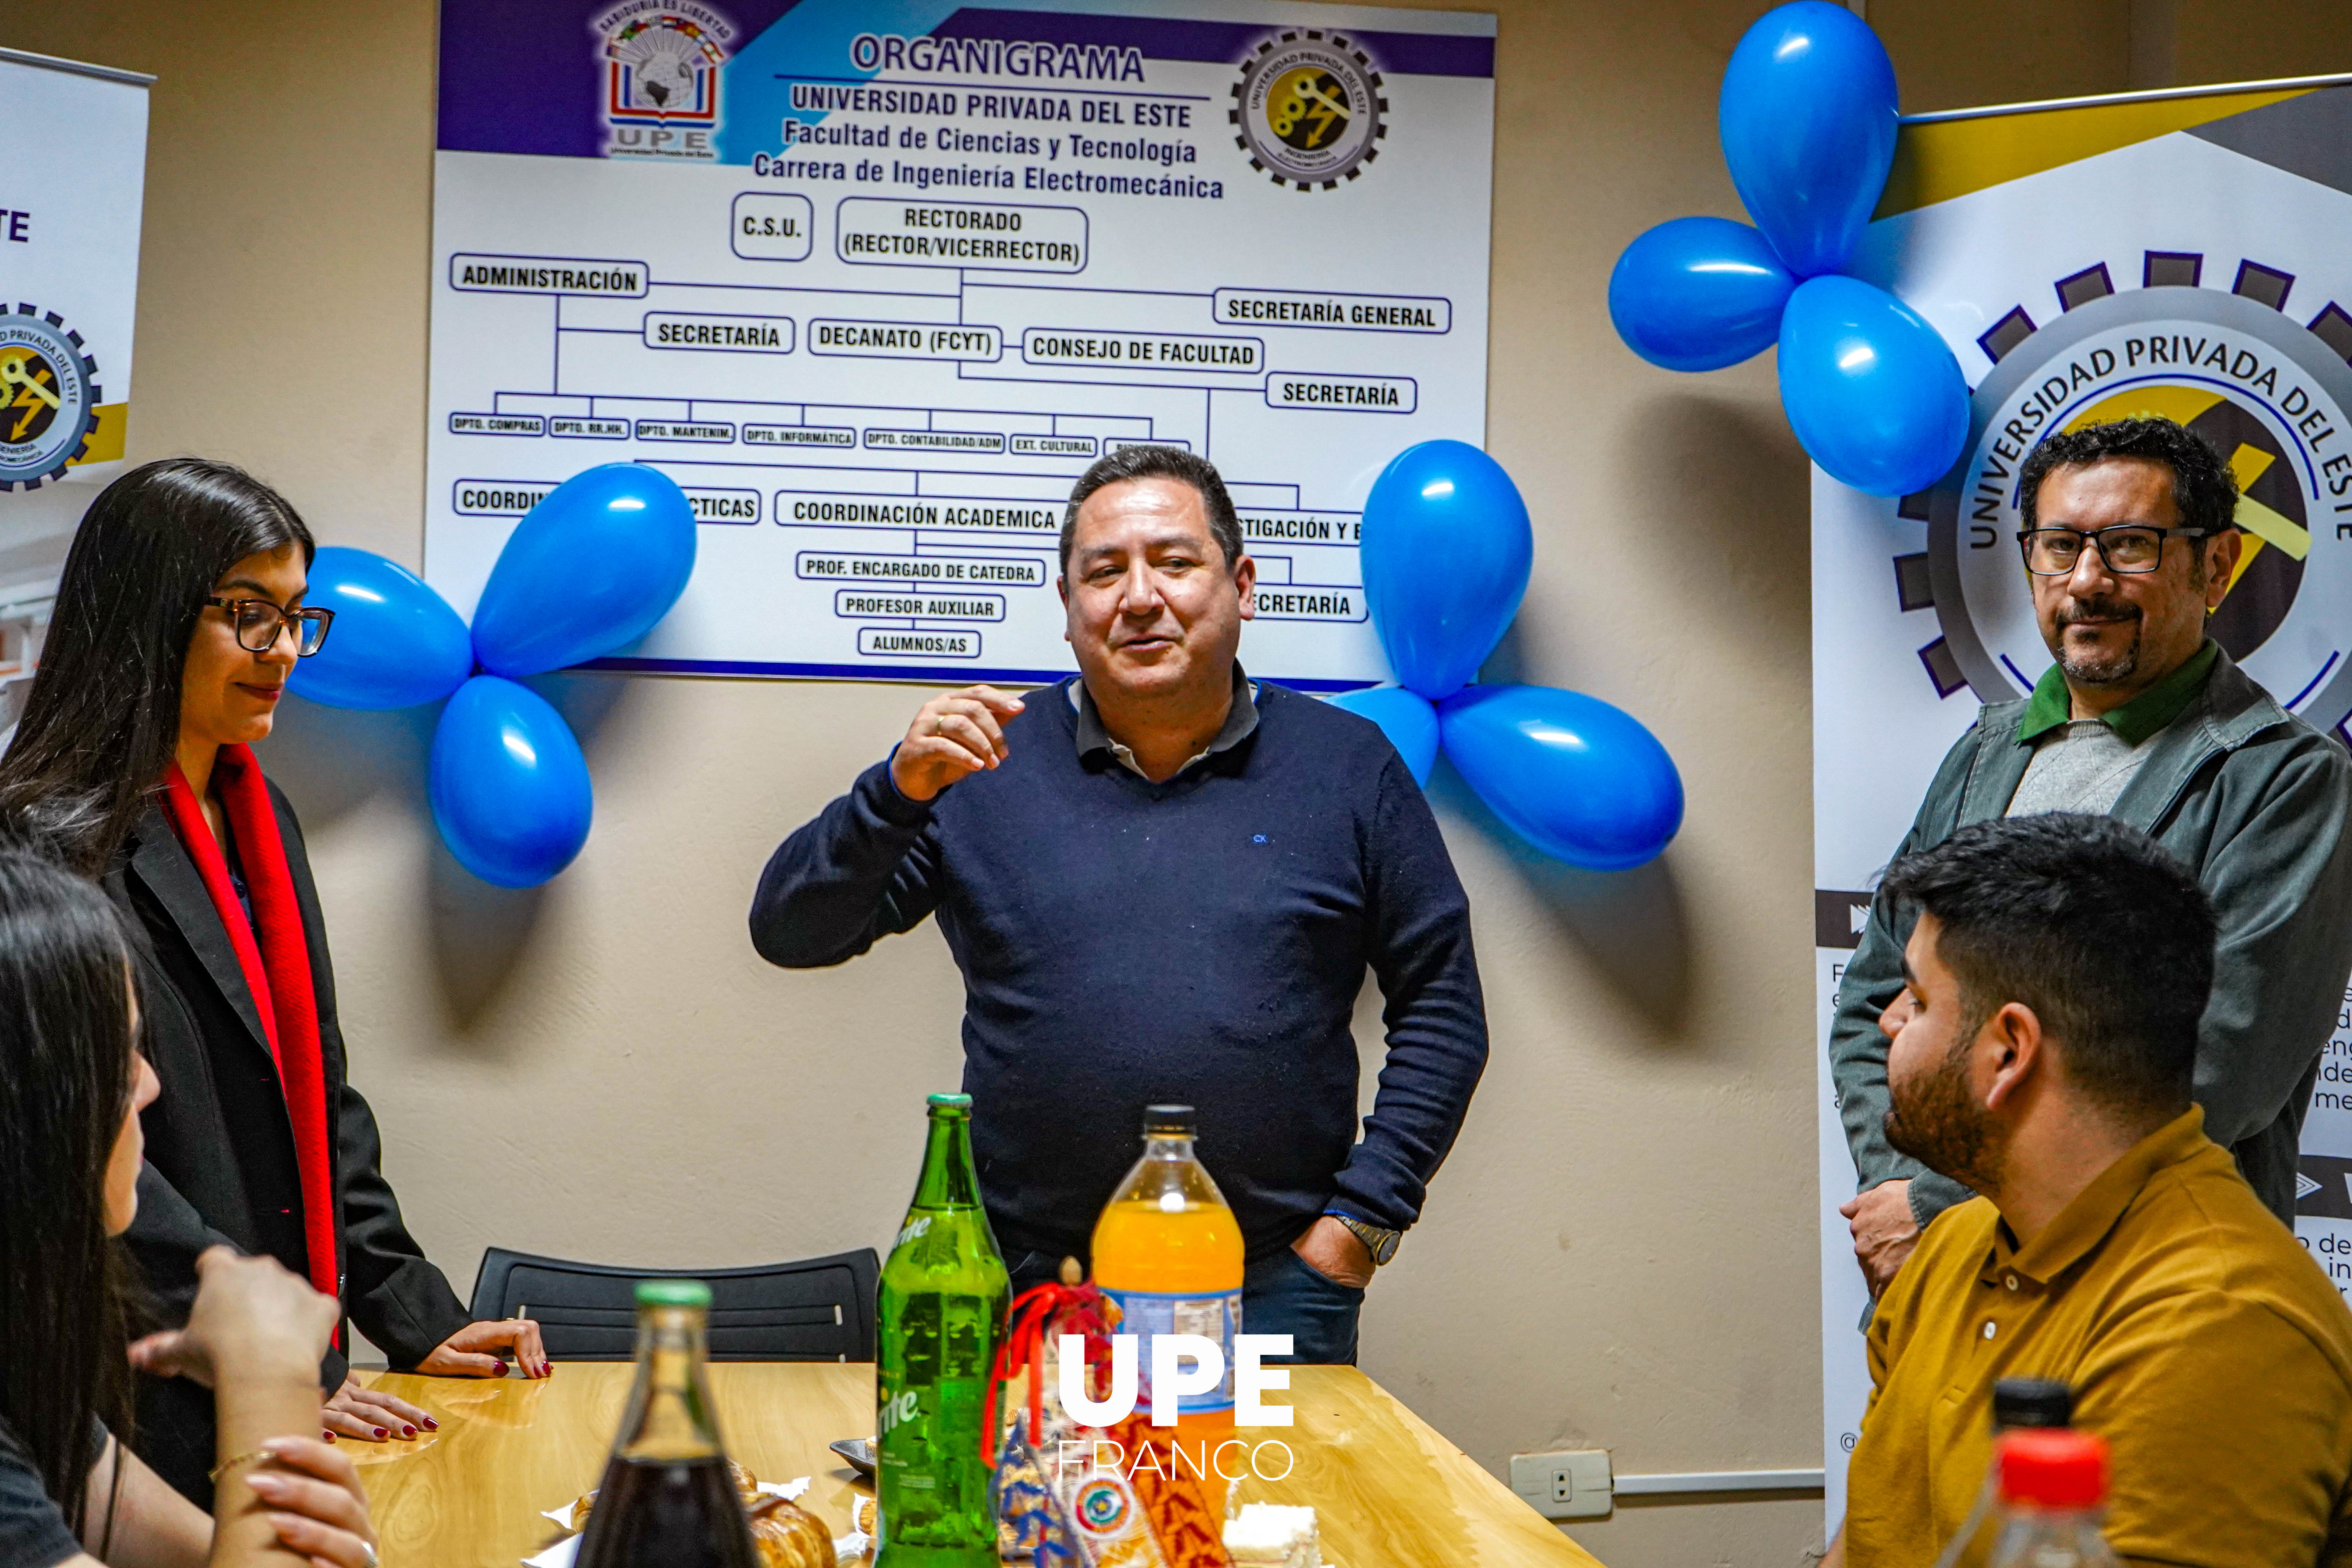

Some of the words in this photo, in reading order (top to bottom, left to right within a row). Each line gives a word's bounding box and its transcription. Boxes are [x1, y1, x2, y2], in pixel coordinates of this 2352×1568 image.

[854, 36, 1145, 83] ORGANIGRAMA
[793, 85, 956, 116] UNIVERSIDAD
[967, 94, 1071, 121] PRIVADA
[1082, 101, 1125, 124] DEL
[1134, 103, 1191, 128] ESTE
[618, 129, 708, 149] UPE
[785, 120, 890, 148] Facultad
[900, 126, 927, 149] de
[938, 127, 1040, 155] Ciencias
[1049, 138, 1061, 160] y
[1069, 134, 1197, 167] Tecnología
[754, 154, 846, 180] Carrera
[856, 159, 884, 182] de
[894, 160, 1014, 189] Ingeniería
[1025, 167, 1223, 198] Electromecánica
[743, 216, 802, 237] C.S.U.
[905, 208, 1022, 232] RECTORADO
[845, 234, 1080, 265] (RECTOR/VICERRECTOR)
[463, 265, 637, 291] ADMINISTRACIÓN
[1229, 299, 1344, 323] SECRETARÍA
[1352, 305, 1436, 327] GENERAL
[659, 322, 781, 346] SECRETARÍA
[820, 326, 920, 348] DECANATO
[930, 330, 992, 356] (FCYT)
[1033, 337, 1121, 359] CONSEJO
[1129, 342, 1153, 360] DE
[1161, 343, 1254, 365] FACULTAD
[10, 329, 56, 355] PRIVADA
[56, 353, 72, 374] DEL
[67, 377, 78, 405] ESTE
[1283, 383, 1399, 406] SECRETARÍA
[454, 418, 485, 429] DPTO.
[488, 419, 541, 431] COMPRAS
[555, 422, 585, 433] DPTO.
[639, 424, 669, 436] DPTO.
[673, 426, 733, 439] MANTENIM.
[747, 430, 777, 441] DPTO.
[781, 430, 851, 444] INFORMÁTICA
[868, 434, 898, 445] DPTO.
[902, 434, 1001, 448] CONTABILIDAD/ADM
[1016, 439, 1037, 450] EXT.
[1040, 441, 1093, 453] CULTURAL
[1970, 348, 2116, 549] UNIVERSIDAD
[2125, 335, 2277, 397] PRIVADA
[2279, 386, 2335, 454] DEL
[463, 490, 548, 509] COORDI
[689, 498, 755, 517] TICAS
[795, 501, 937, 524] COORDINACIÓN
[945, 508, 1056, 528] ACADEMICA
[1238, 516, 1330, 539] TIGACIÓN
[1337, 523, 1347, 539] Y
[807, 560, 847, 575] PROF.
[853, 562, 940, 578] ENCARGADO
[947, 565, 964, 579] DE
[970, 566, 1035, 581] CATEDRA
[846, 598, 922, 614] PROFESOR
[929, 601, 994, 616] AUXILIAR
[1253, 592, 1350, 615] CRETARÍA
[873, 636, 967, 652] ALUMNOS/AS
